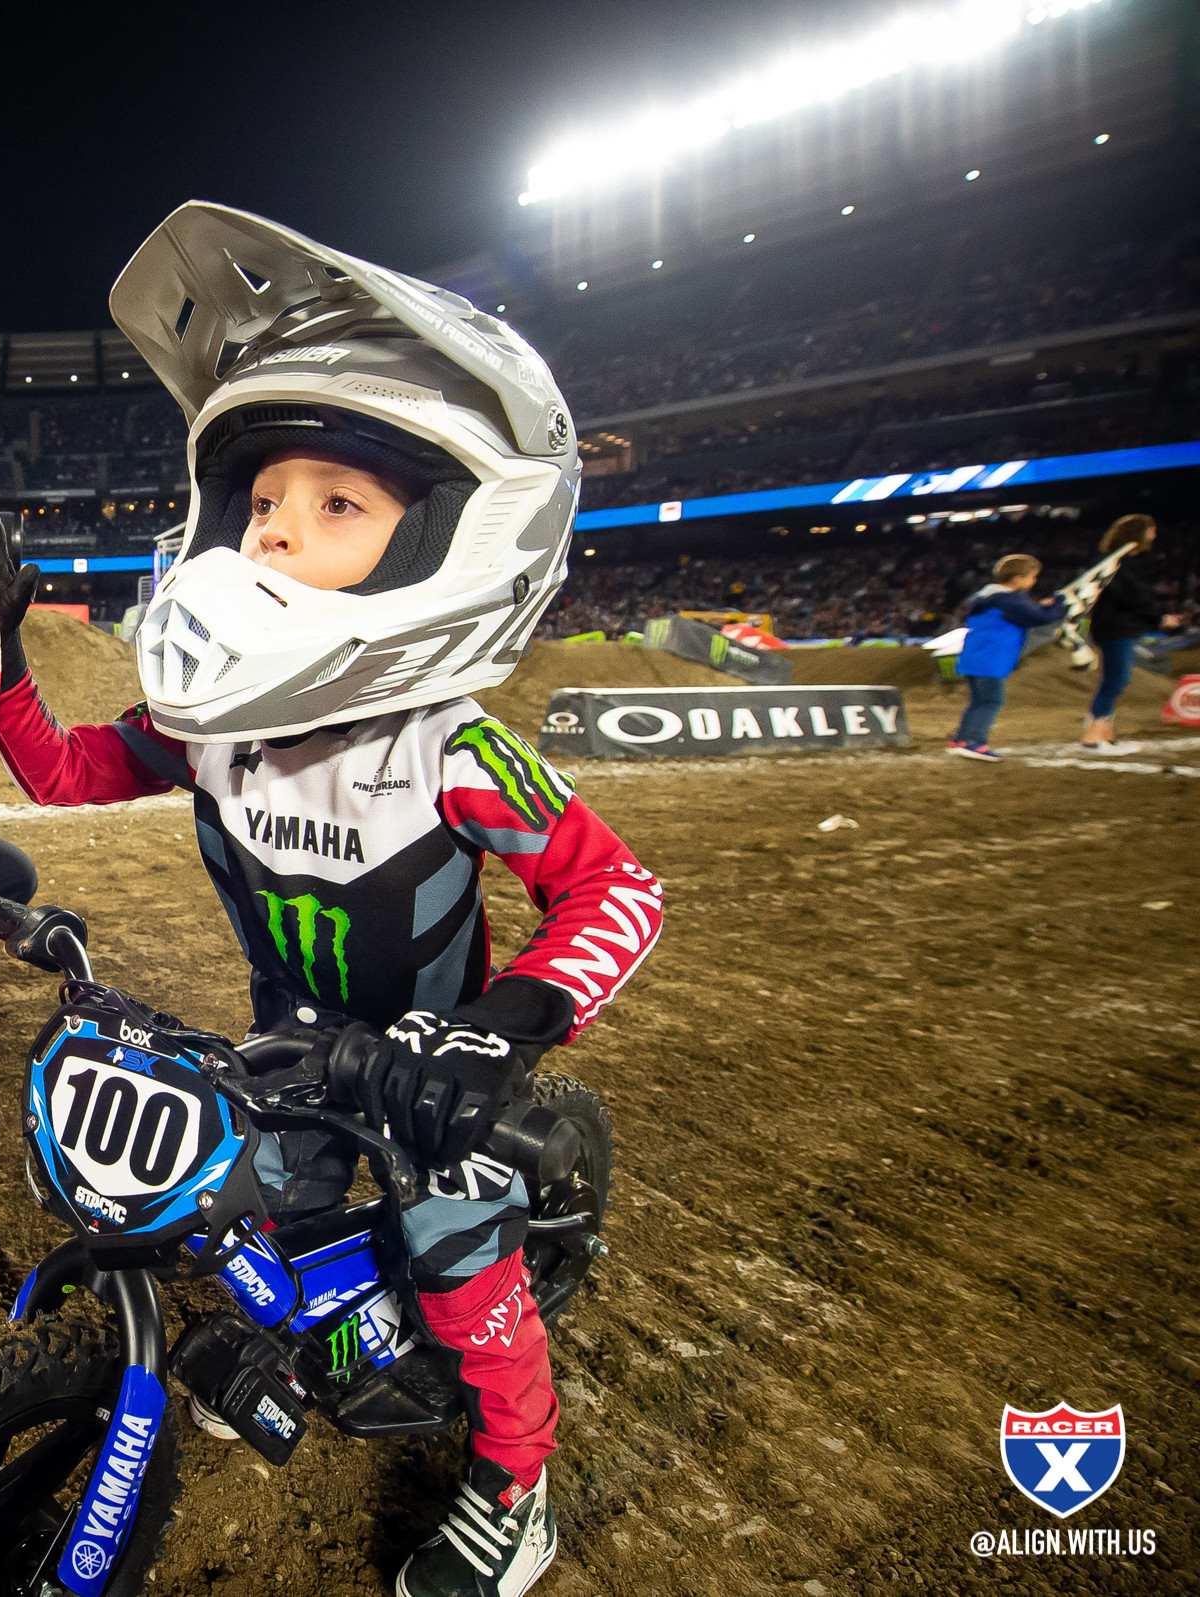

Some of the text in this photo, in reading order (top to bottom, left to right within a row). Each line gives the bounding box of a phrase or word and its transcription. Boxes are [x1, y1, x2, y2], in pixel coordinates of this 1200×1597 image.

[687, 704, 898, 741] OAKLEY
[245, 806, 366, 864] YAMAHA
[119, 1019, 154, 1049] box
[60, 1068, 189, 1188] 100
[74, 1185, 128, 1225] STACYC
[227, 1254, 276, 1307] STACYC
[308, 1287, 338, 1310] YAMAHA
[257, 1394, 297, 1440] STACYC
[84, 1412, 153, 1539] YAMAHA
